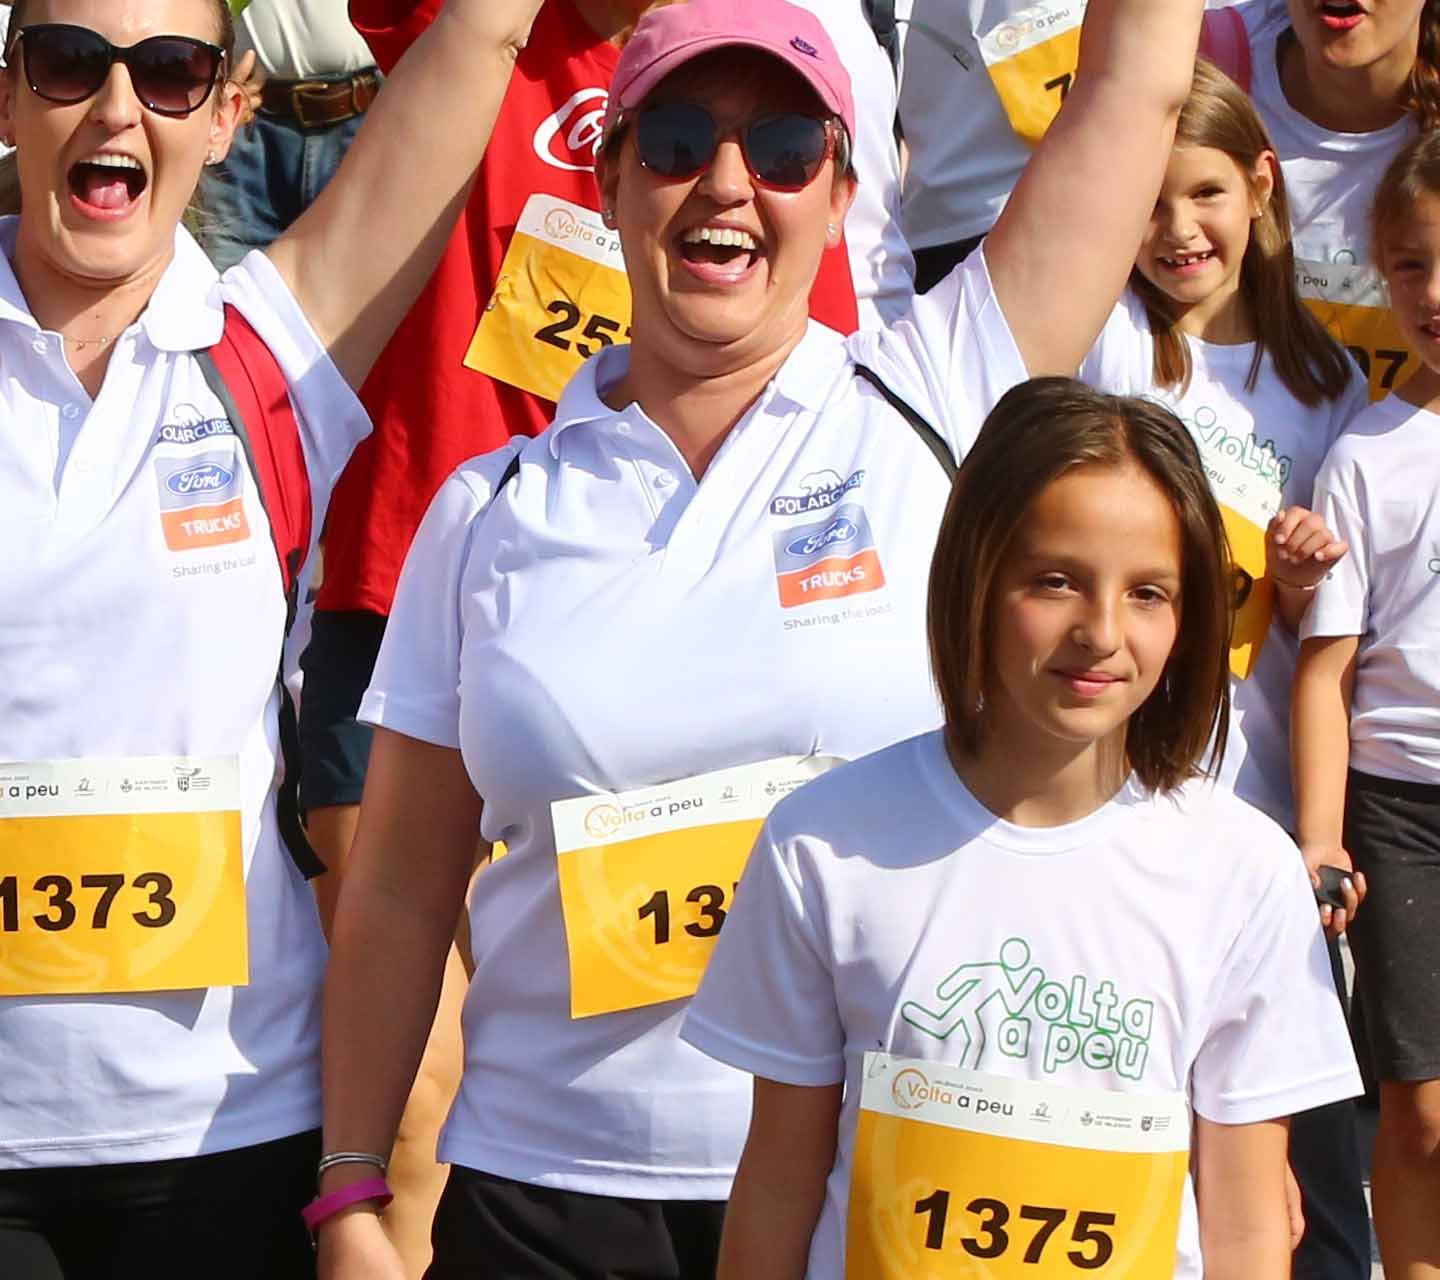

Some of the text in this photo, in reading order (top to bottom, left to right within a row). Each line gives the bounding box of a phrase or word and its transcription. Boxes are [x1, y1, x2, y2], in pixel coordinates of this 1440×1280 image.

[534, 299, 631, 360] 25
[159, 417, 234, 443] OLARCUBE
[179, 465, 224, 491] Ford
[181, 510, 242, 536] TRUCKS
[804, 522, 851, 554] Ford
[172, 560, 223, 579] Sharing
[799, 568, 866, 593] TRUCKS
[783, 611, 841, 631] Sharing
[8, 784, 21, 800] a
[25, 783, 60, 801] peu
[597, 794, 704, 826] Volta a peu
[637, 881, 738, 946] 13
[1001, 966, 1154, 1042] Volta
[998, 1017, 1151, 1081] a peu
[907, 1081, 953, 1105] Volta
[957, 1093, 970, 1109] a
[974, 1095, 1015, 1117] peu
[914, 1188, 1117, 1270] 1375
